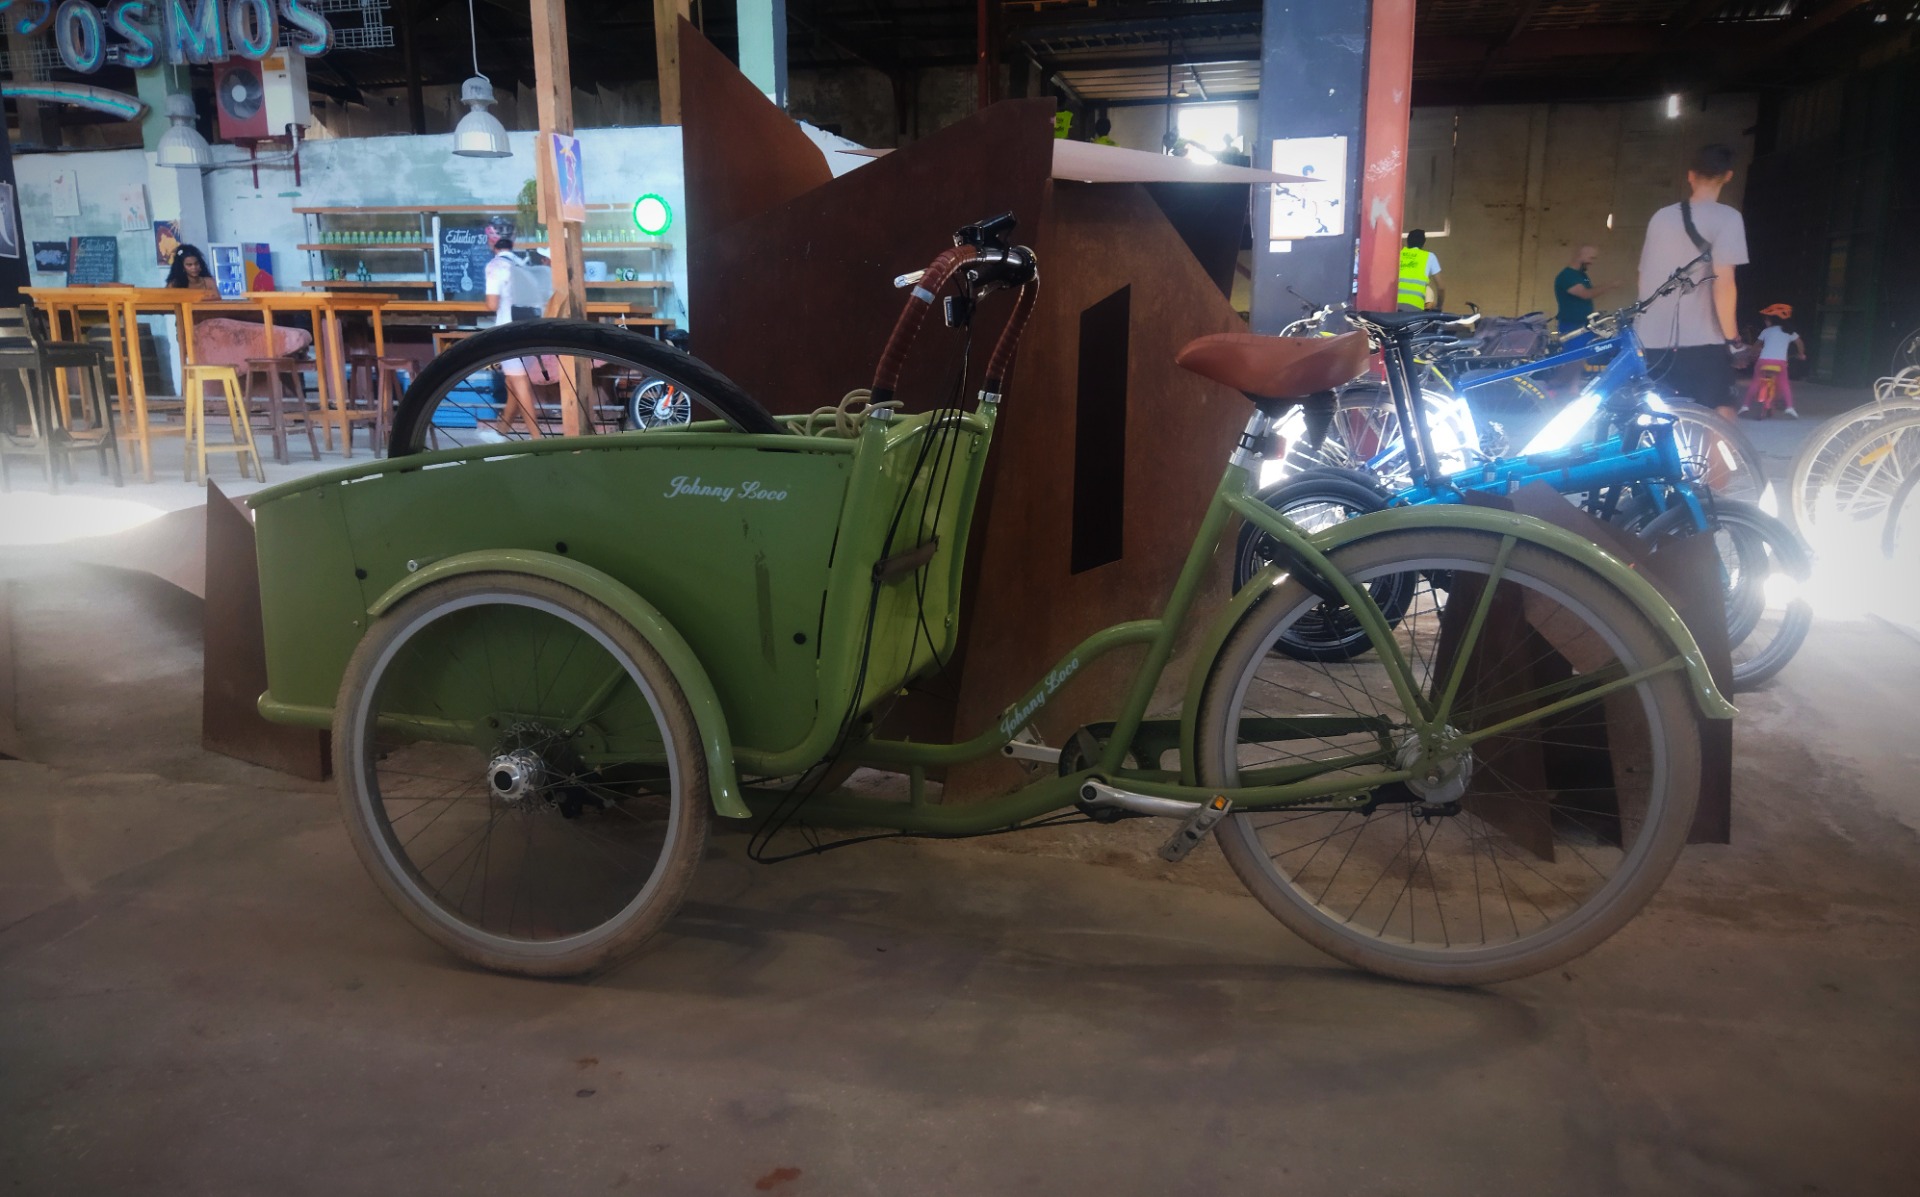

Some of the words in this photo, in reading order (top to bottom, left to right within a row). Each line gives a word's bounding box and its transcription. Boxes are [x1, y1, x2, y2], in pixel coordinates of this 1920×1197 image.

[446, 230, 476, 244] Estudio
[477, 234, 487, 245] 50
[663, 476, 735, 502] Johnny
[737, 481, 788, 501] Loco
[1000, 690, 1046, 739] Johnny
[1045, 657, 1079, 694] Loco
